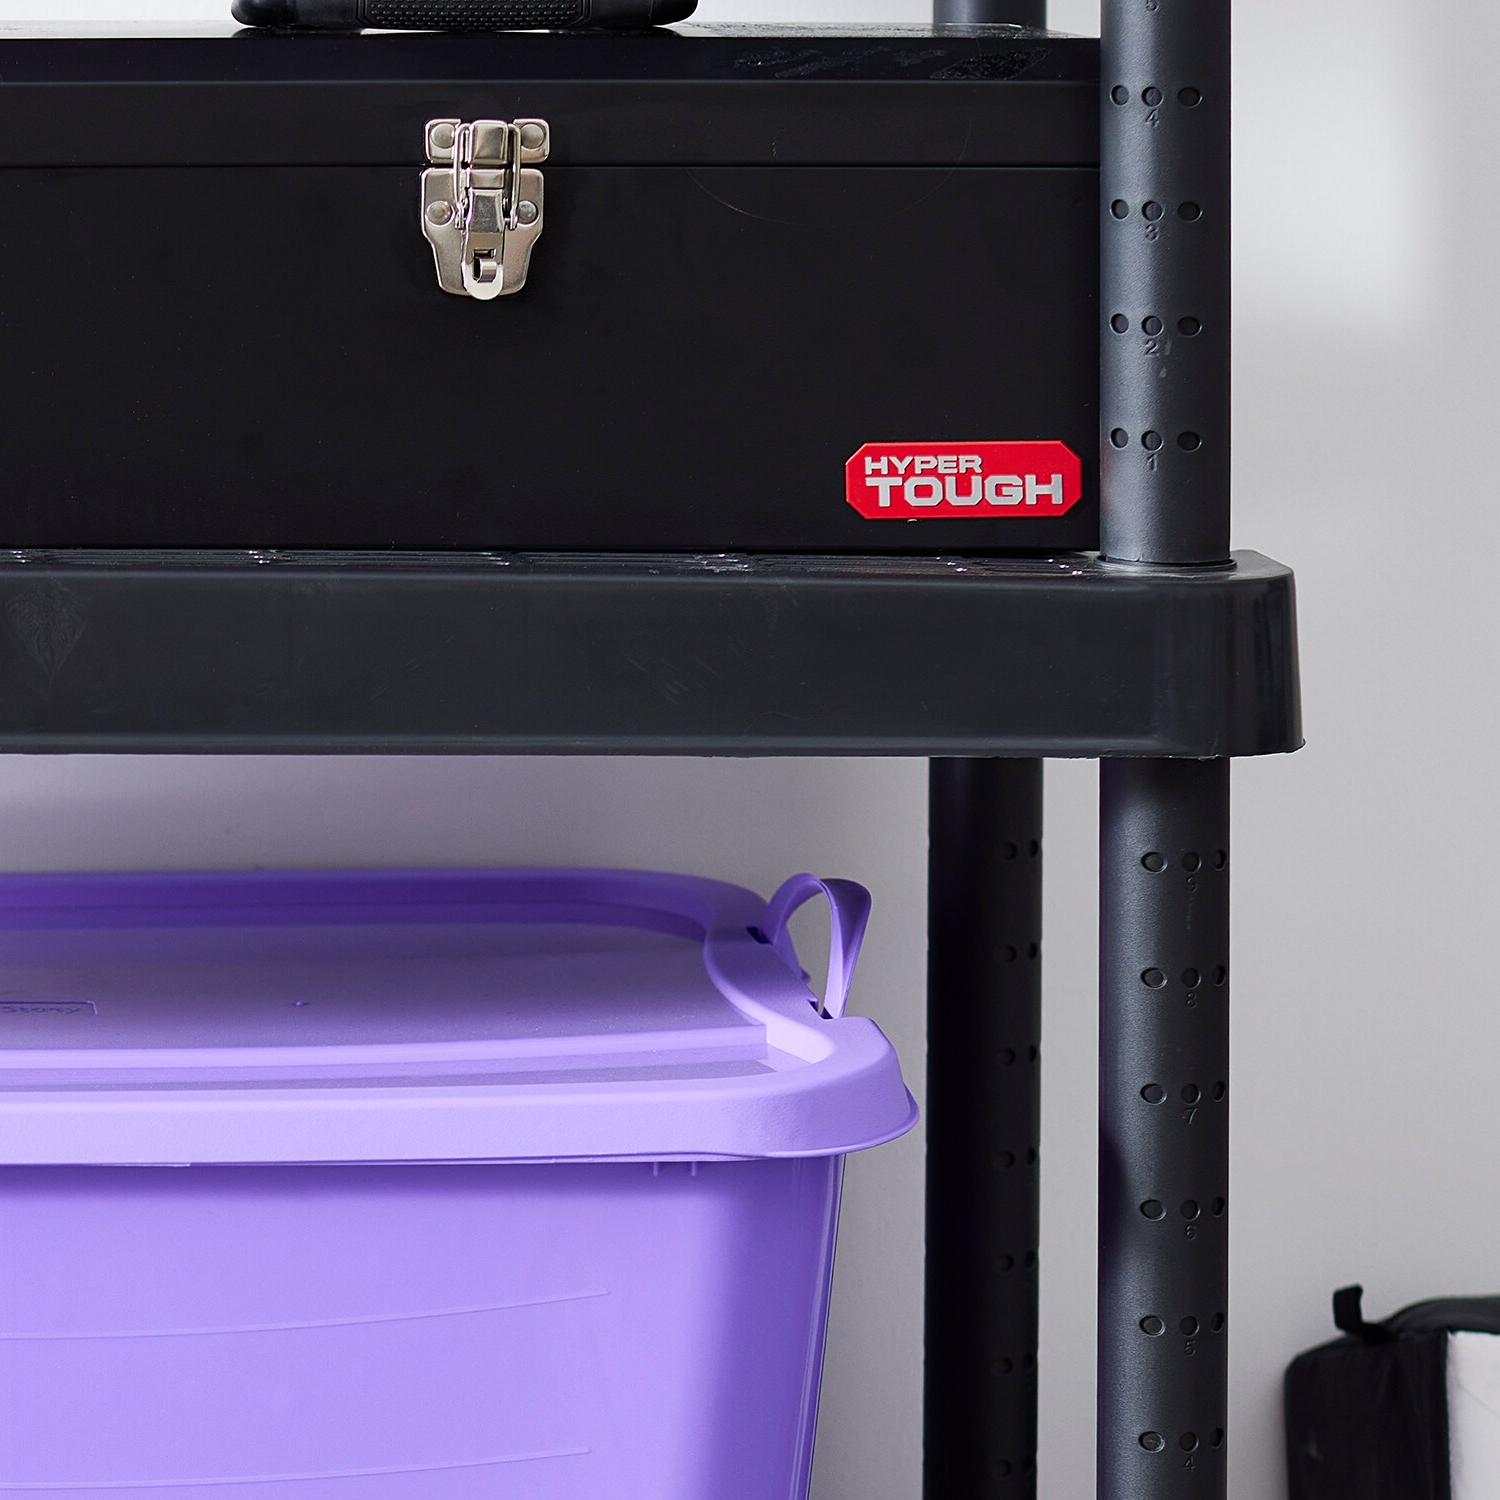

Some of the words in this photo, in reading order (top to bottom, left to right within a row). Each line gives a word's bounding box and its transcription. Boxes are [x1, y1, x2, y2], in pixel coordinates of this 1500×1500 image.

[1145, 338, 1160, 357] 2
[864, 454, 982, 475] HYPER
[865, 474, 1063, 507] TOUGH
[1, 1005, 82, 1015] Story
